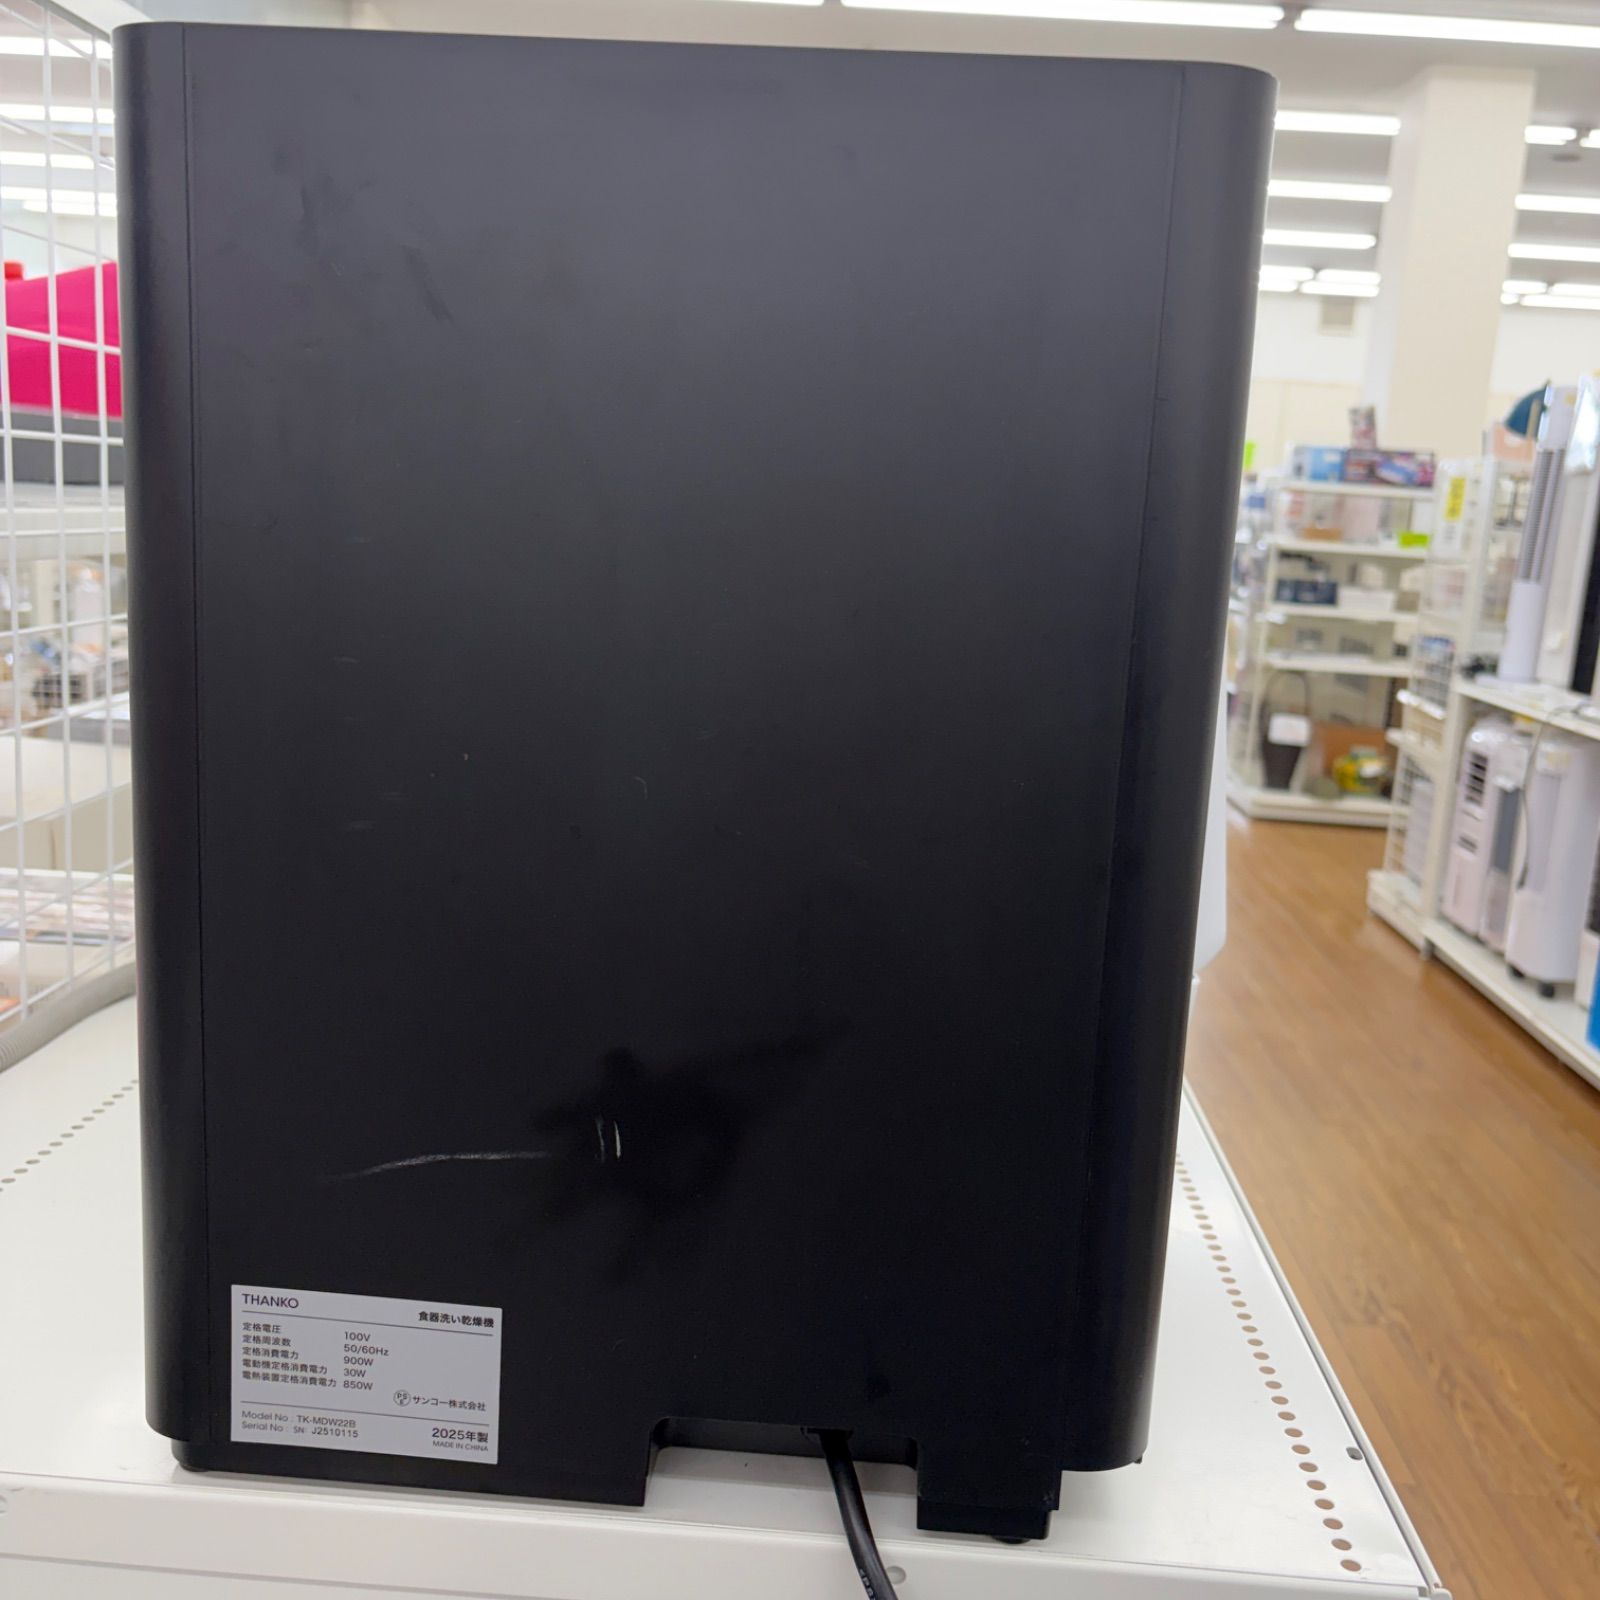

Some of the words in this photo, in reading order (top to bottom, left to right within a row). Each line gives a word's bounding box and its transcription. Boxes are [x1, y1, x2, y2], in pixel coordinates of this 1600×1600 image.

[242, 1293, 299, 1309] THANKO
[418, 1311, 494, 1328] 食器洗い乾燥機
[242, 1322, 282, 1334] 定格電圧
[344, 1331, 371, 1342] 100V
[242, 1334, 292, 1347] 定格周波数
[343, 1343, 389, 1356] 50/60Hz
[242, 1346, 299, 1360] 定格消費電力
[343, 1356, 374, 1367] 900W
[242, 1358, 328, 1375] 電動機定格消費電力
[343, 1368, 367, 1378] 30W
[343, 1380, 373, 1390] 850W
[412, 1395, 487, 1412] サンコー株式会社
[241, 1410, 273, 1421] Model
[296, 1415, 357, 1429] TK-MDW22B
[241, 1421, 268, 1431] Serial
[311, 1426, 359, 1438] J2510115
[431, 1427, 489, 1444] 2025年製
[432, 1440, 454, 1450] MADE
[464, 1443, 489, 1452] CHINA
